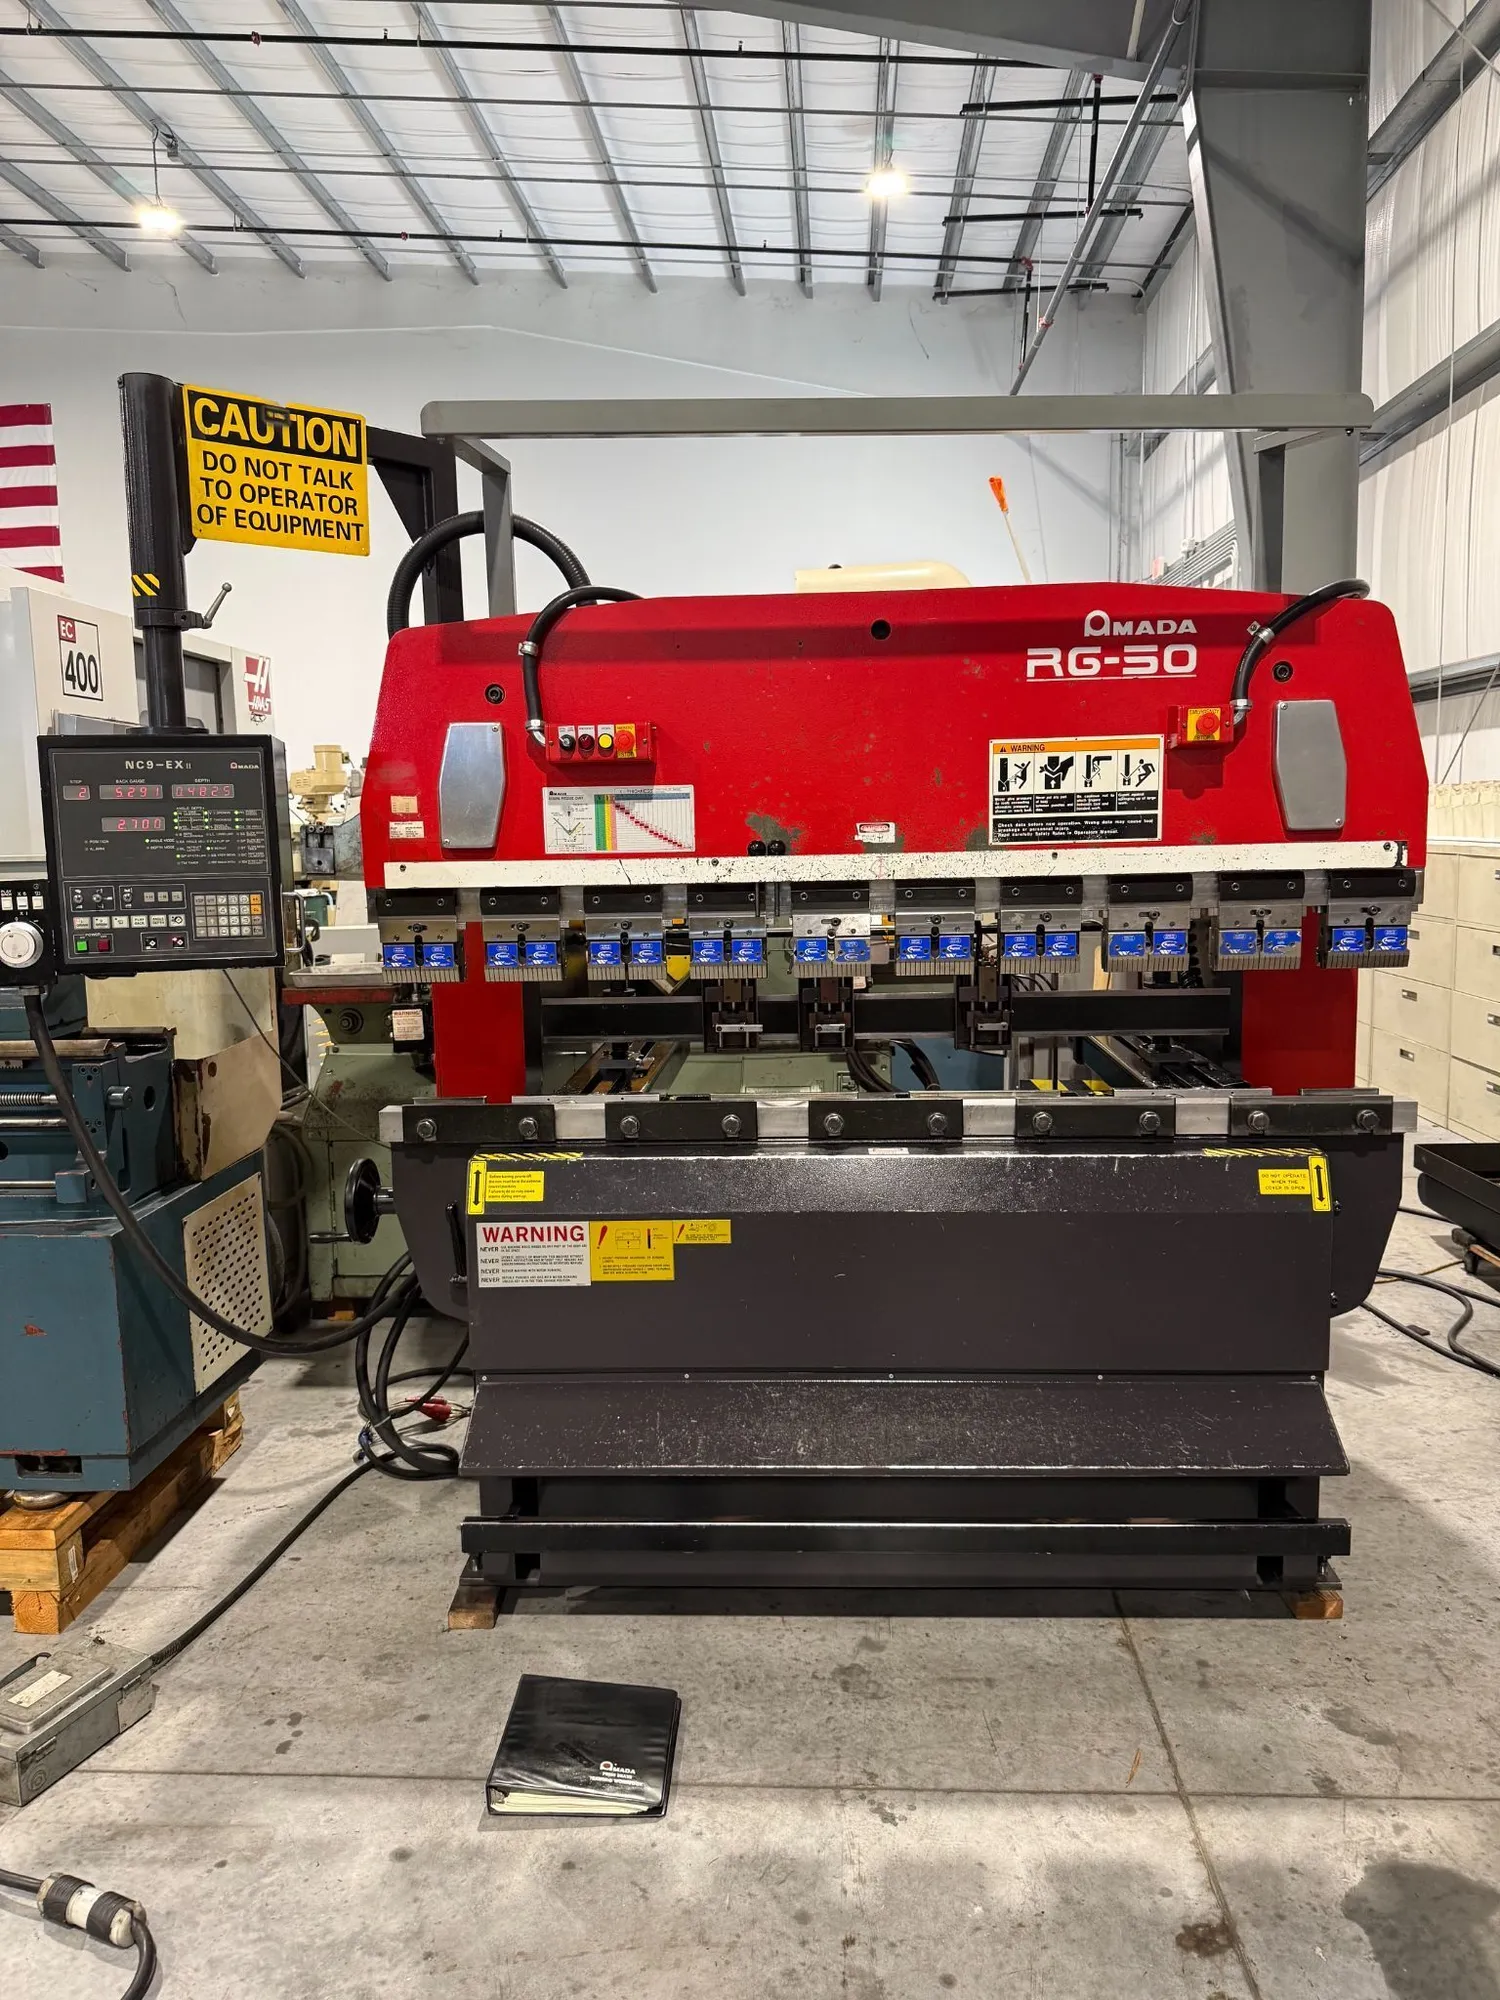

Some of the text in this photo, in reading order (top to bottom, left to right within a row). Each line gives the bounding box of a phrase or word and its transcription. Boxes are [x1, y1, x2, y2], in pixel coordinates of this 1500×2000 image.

[193, 397, 357, 457] CAUTION
[202, 450, 353, 490] DO NOT TALK
[200, 477, 358, 516] TO OPERATOR
[197, 503, 364, 542] OF EQUIPMENT
[59, 619, 75, 639] EC
[1084, 609, 1197, 637] AMADA
[65, 650, 99, 693] 400
[1026, 644, 1197, 678] RG-50
[1010, 744, 1046, 753] WARNING
[125, 760, 184, 770] NC9-EX
[78, 787, 87, 798] 2
[482, 1225, 584, 1243] WARNING
